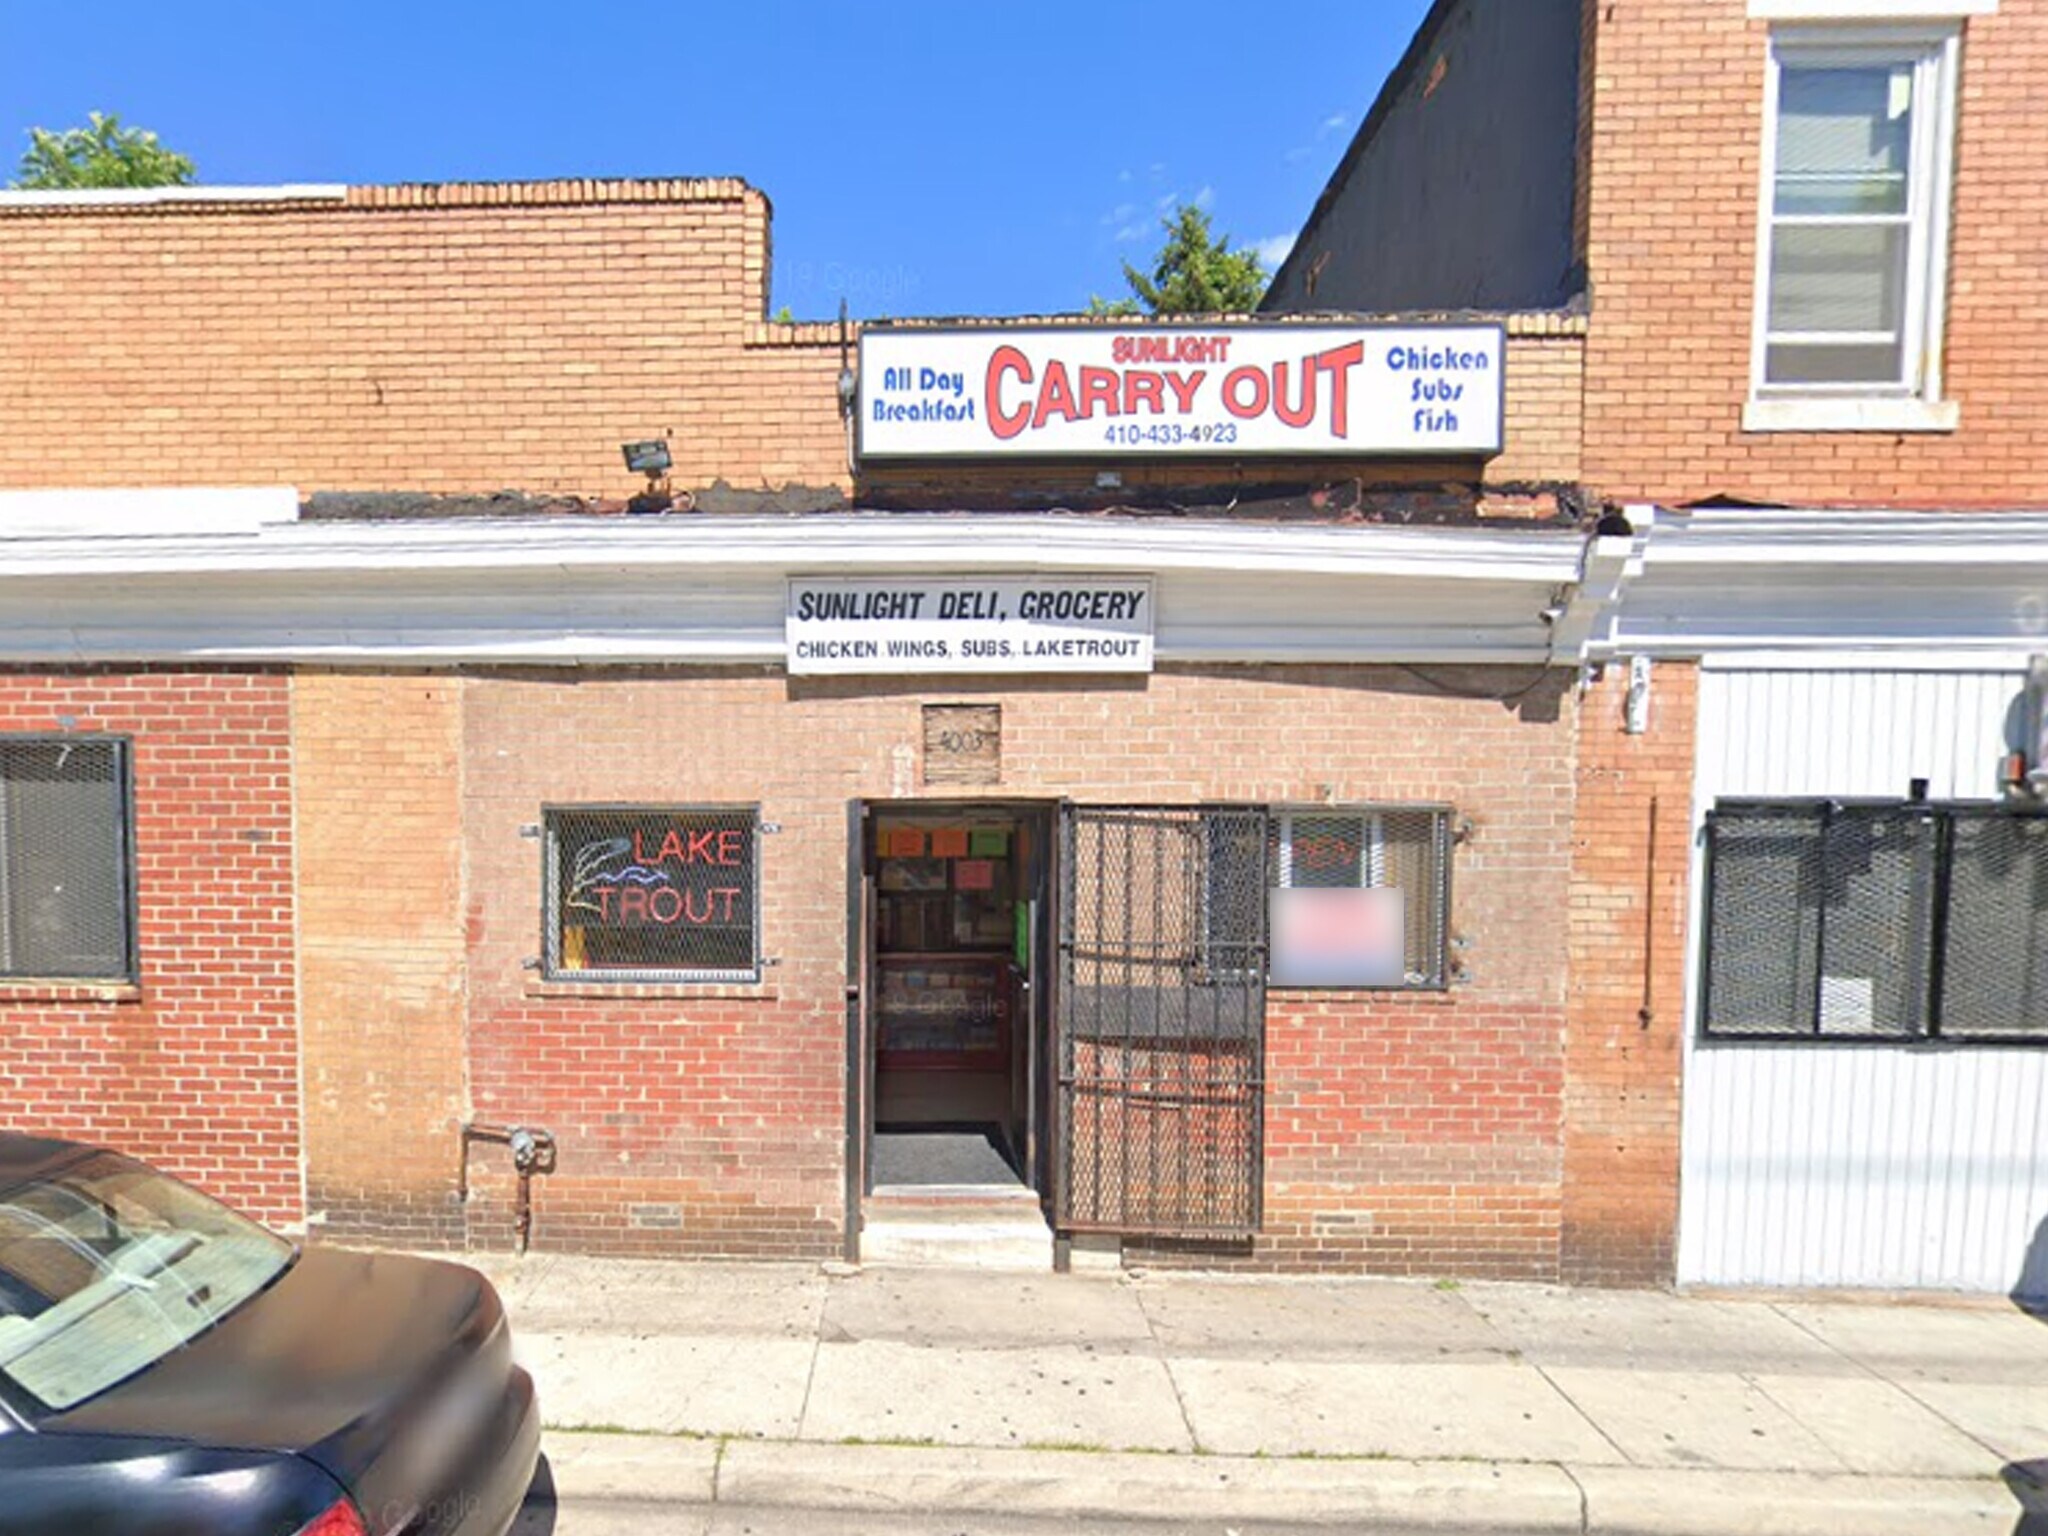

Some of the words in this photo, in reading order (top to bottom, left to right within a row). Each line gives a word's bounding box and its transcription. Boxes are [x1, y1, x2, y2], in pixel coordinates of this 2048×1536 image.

[1112, 336, 1232, 363] SUNLIGHT
[1387, 346, 1489, 371] Chicken
[883, 366, 913, 391] All
[921, 367, 965, 397] Day
[985, 345, 1206, 440] CARRY
[1221, 340, 1363, 439] OUT
[1411, 378, 1463, 401] Subs
[872, 397, 975, 422] Breakfast
[1413, 411, 1458, 432] Fish
[1104, 423, 1238, 445] 410-433-4923
[798, 591, 925, 621] SUNLIGHT
[938, 591, 1007, 622] DELI,
[1018, 590, 1145, 620] GROCERY
[796, 640, 879, 658] CHICKEN
[886, 640, 952, 659] WINGS,
[961, 640, 1015, 658] SUBS,
[1022, 640, 1141, 657] LAKETROUT
[938, 730, 984, 753] 4003
[633, 829, 742, 865] LAKE
[592, 886, 740, 923] TROUT
